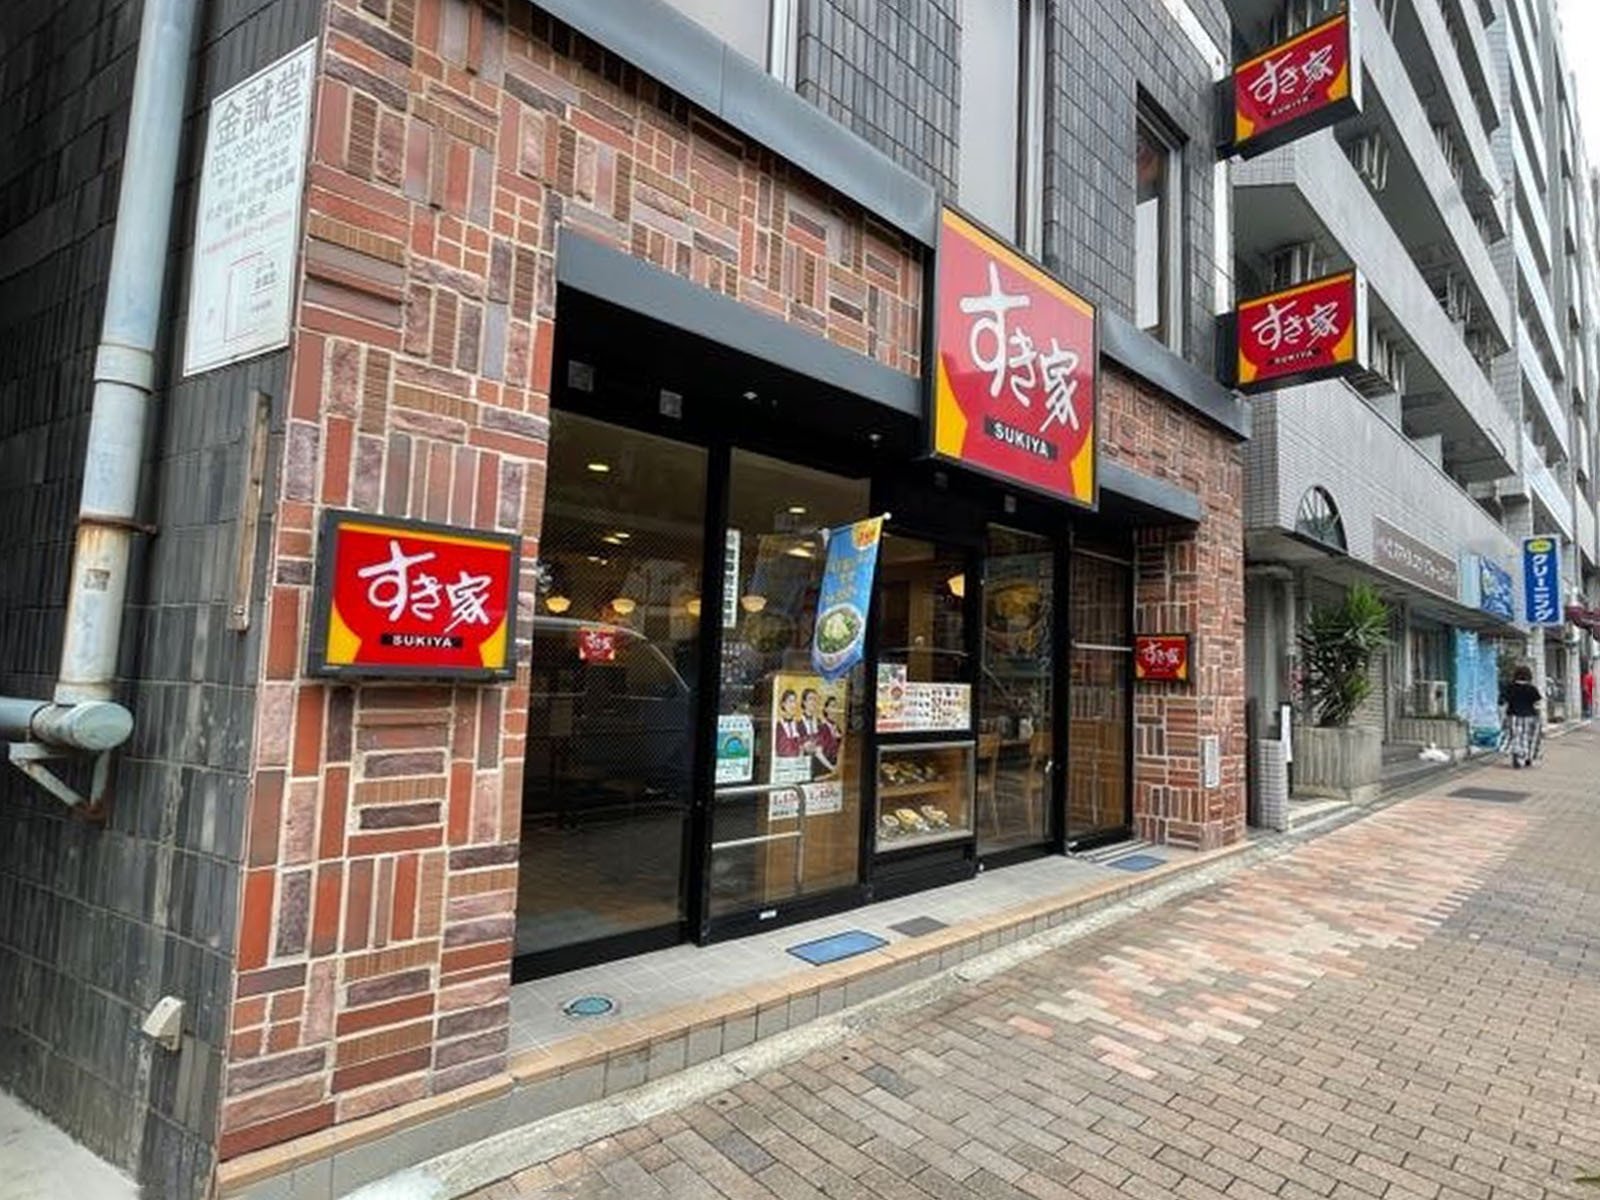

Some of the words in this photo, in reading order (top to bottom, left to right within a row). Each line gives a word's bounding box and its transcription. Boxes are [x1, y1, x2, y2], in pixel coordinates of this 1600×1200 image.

[1247, 43, 1334, 106] すき家
[216, 62, 304, 147] 金誠堂
[959, 259, 1080, 433] すき家
[1251, 300, 1340, 351] すき家
[1274, 349, 1314, 365] SUKIYA
[993, 422, 1050, 458] SUKIYA
[356, 539, 492, 633] すき家
[1532, 554, 1555, 621] クリーニング
[392, 635, 453, 648] SUKIYA
[1141, 640, 1180, 667] すき家
